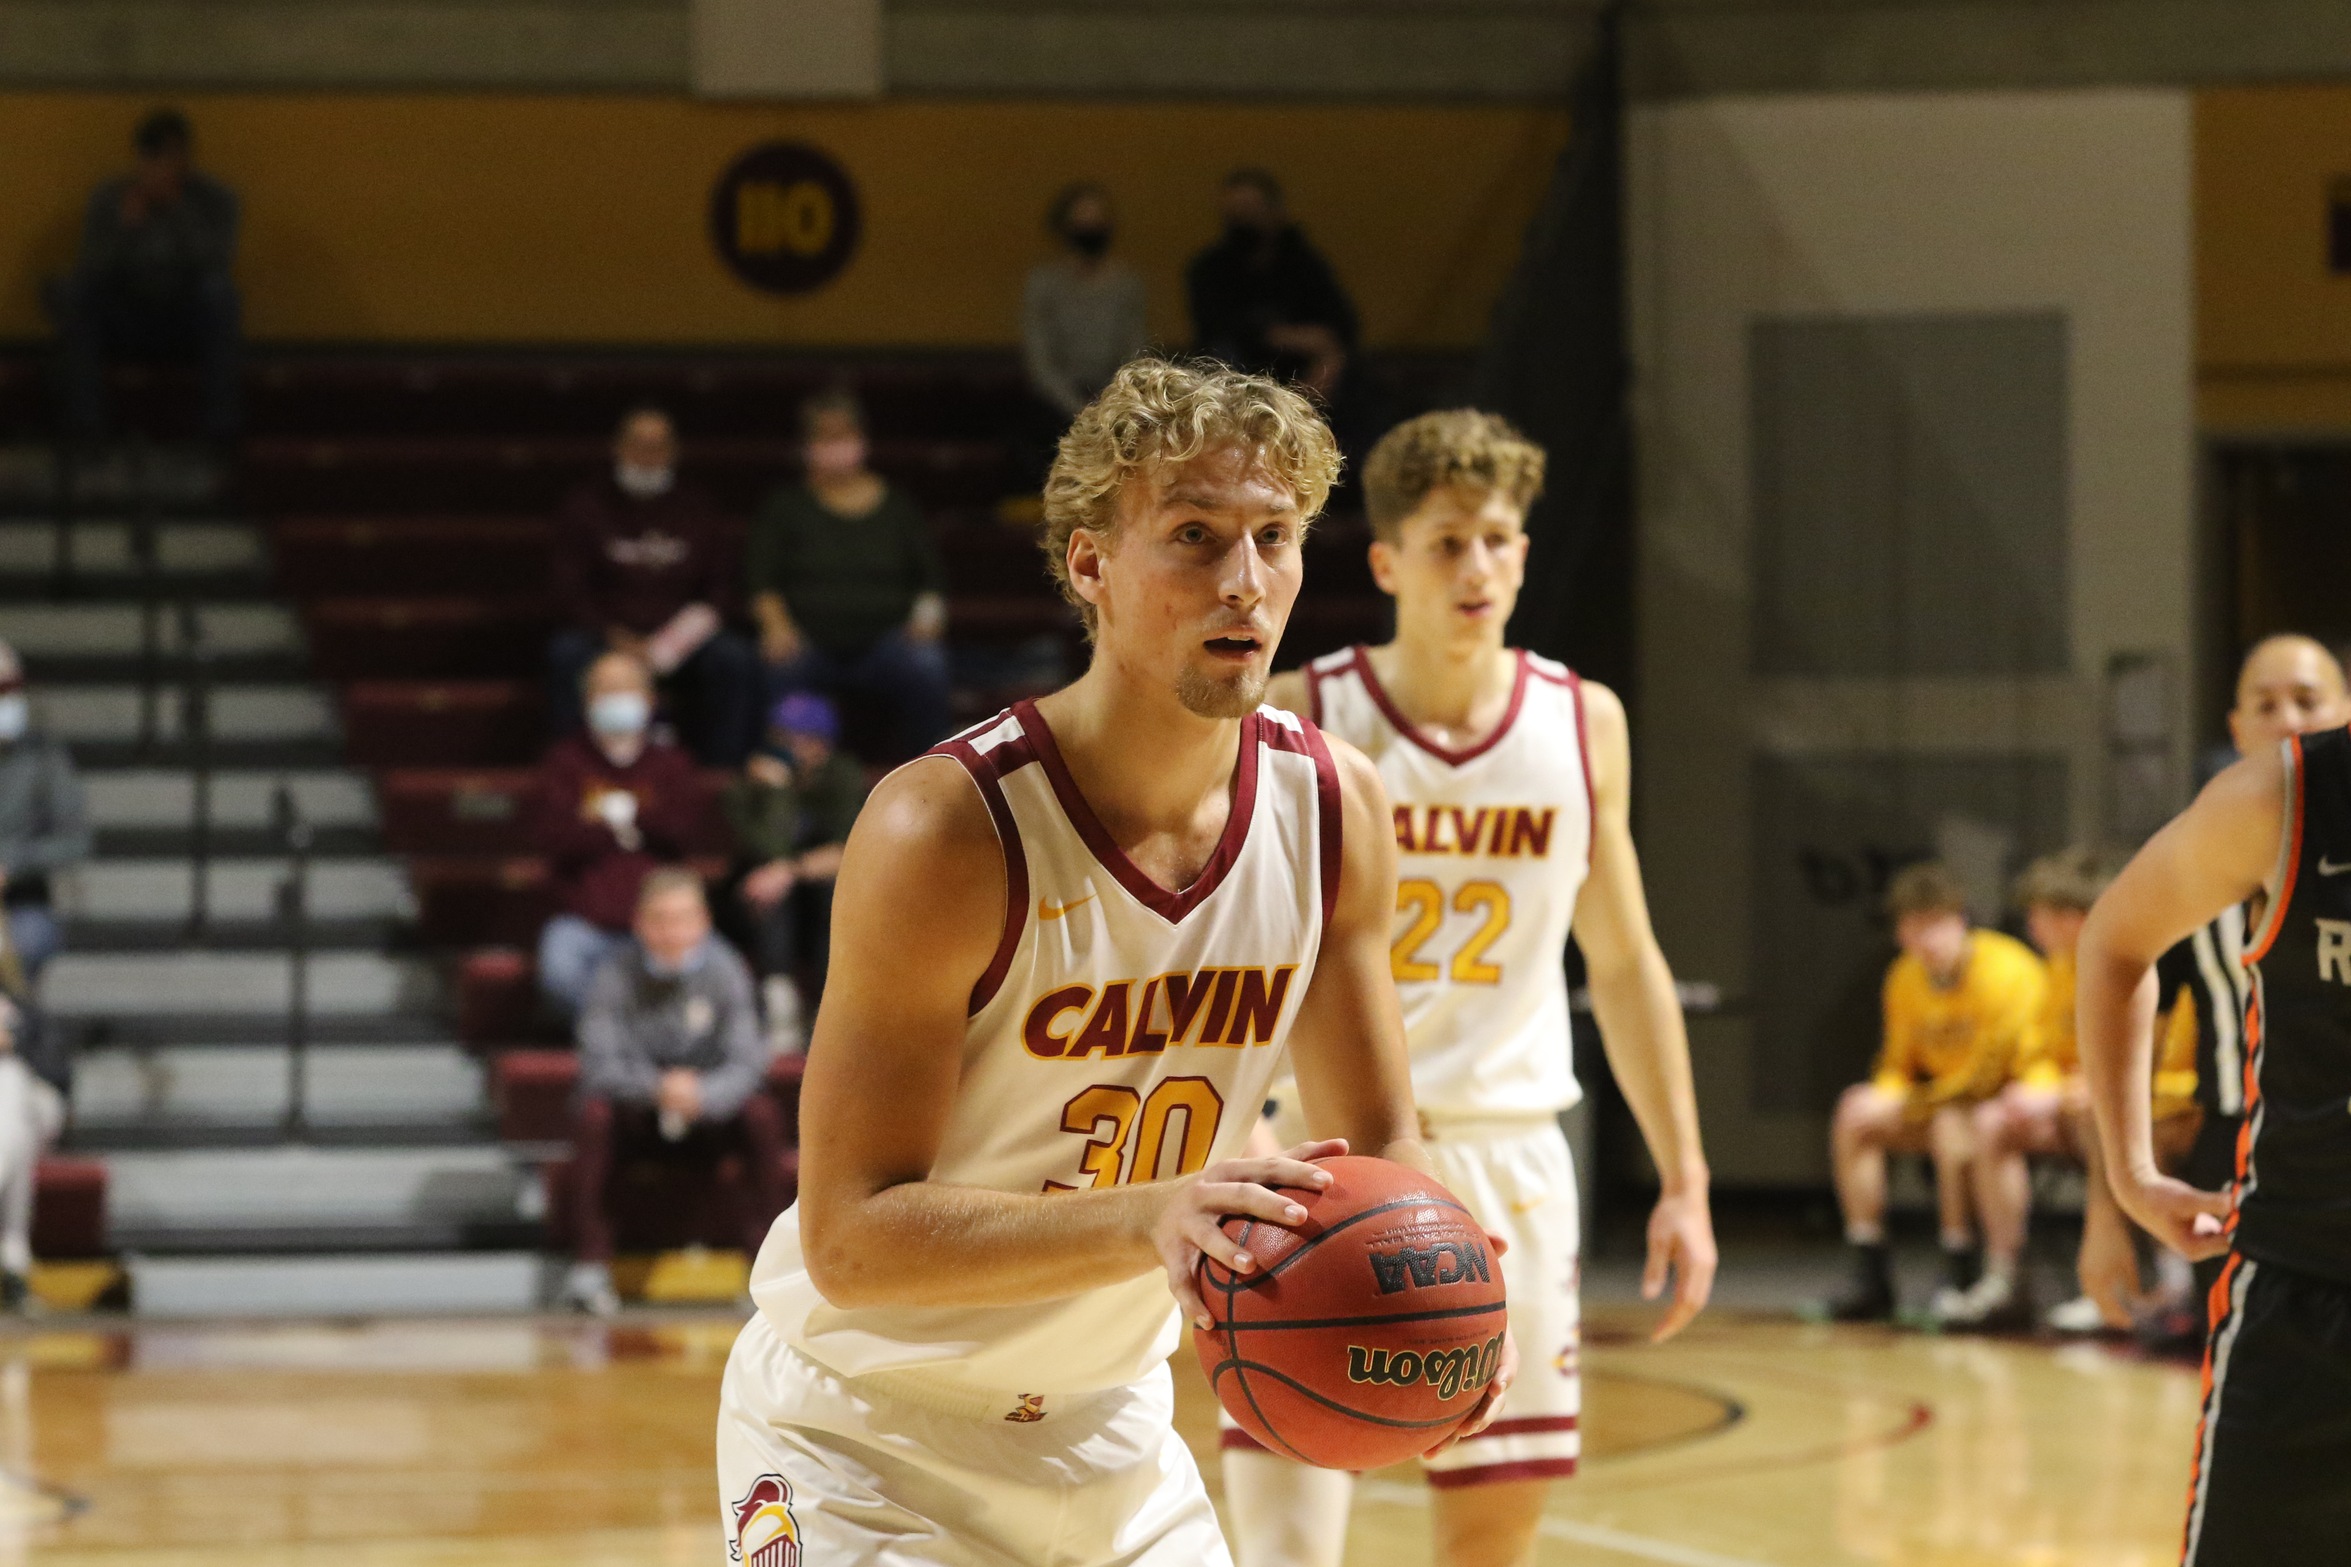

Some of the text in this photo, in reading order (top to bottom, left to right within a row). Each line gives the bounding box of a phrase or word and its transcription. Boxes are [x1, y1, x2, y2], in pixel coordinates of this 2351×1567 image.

[1393, 804, 1560, 858] ALVIN
[1391, 878, 1513, 985] 22
[1021, 963, 1300, 1060] CALVIN
[1041, 1075, 1224, 1196] 30
[1369, 1242, 1491, 1294] NCAA
[1348, 1331, 1504, 1400] Wilson
